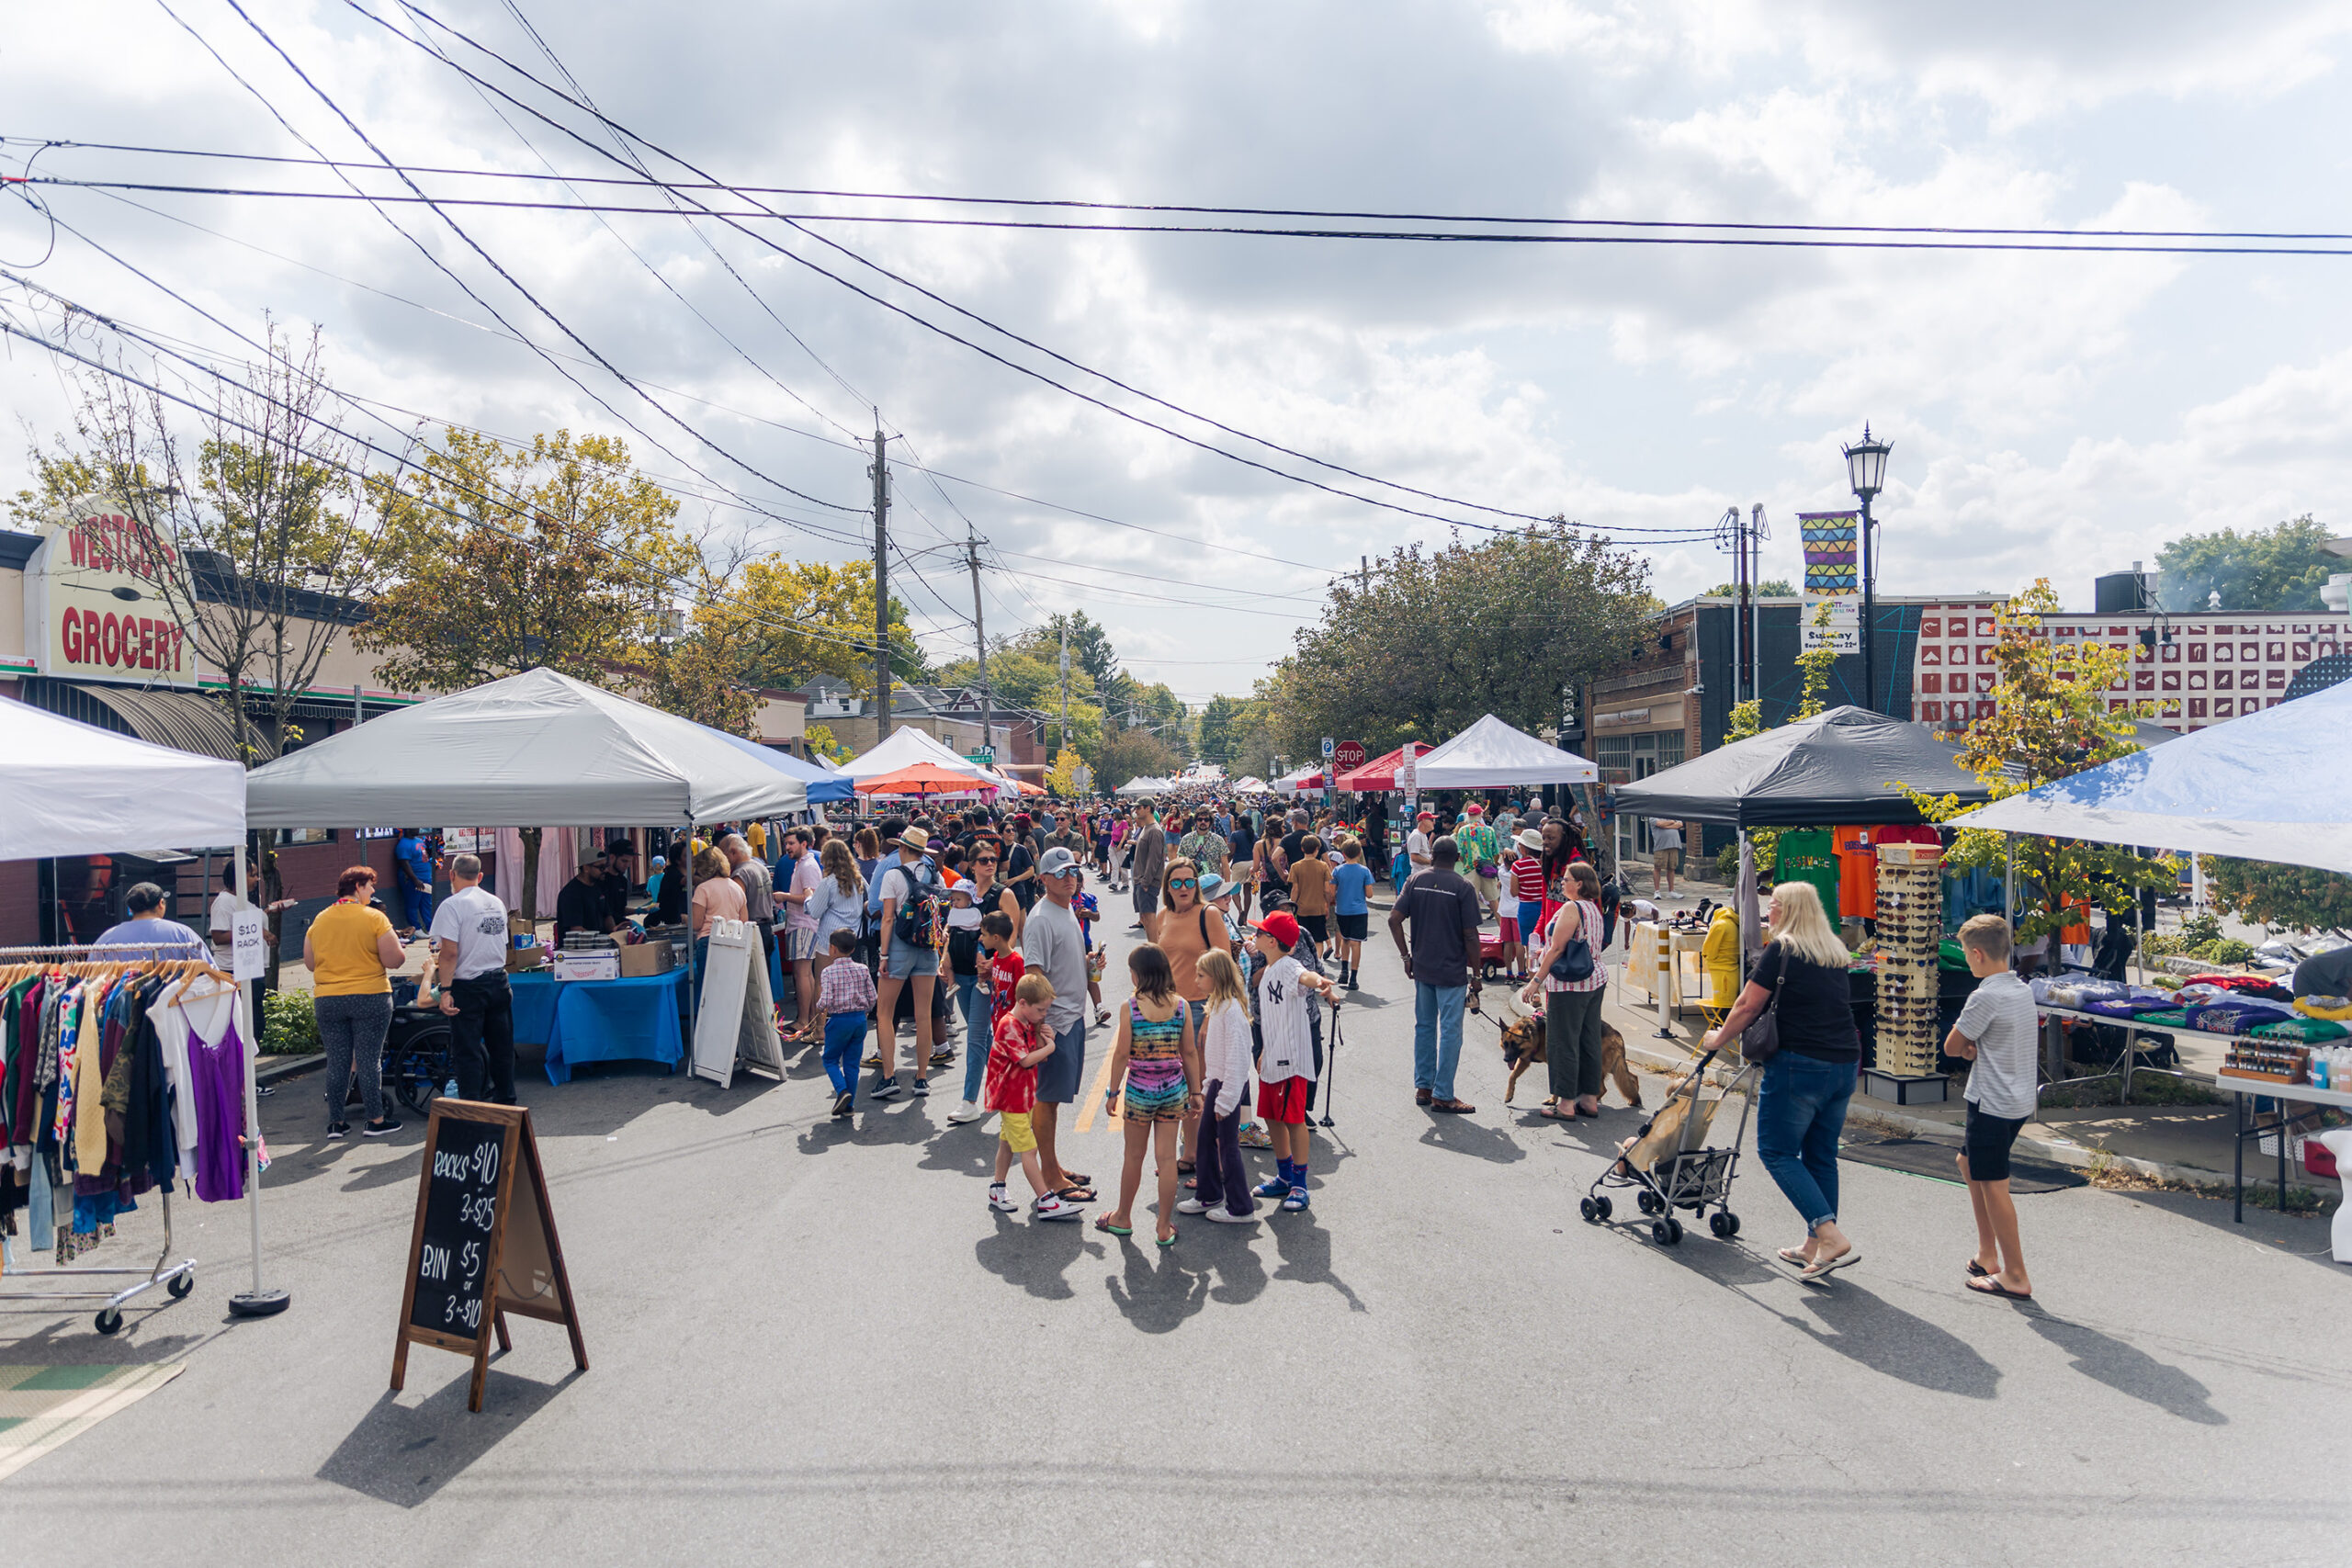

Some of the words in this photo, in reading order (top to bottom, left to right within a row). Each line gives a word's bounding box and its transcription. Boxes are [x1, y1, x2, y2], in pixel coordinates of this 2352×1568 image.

[62, 606, 186, 672] GROCERY
[1808, 631, 1852, 640] Suay
[1337, 750, 1363, 761] STOP
[238, 923, 257, 936] $10
[237, 937, 260, 949] RACK
[434, 1150, 470, 1181] RACKS
[471, 1141, 499, 1185] $10
[421, 1244, 451, 1281] BIN
[460, 1239, 481, 1278] $5
[463, 1280, 473, 1292] or
